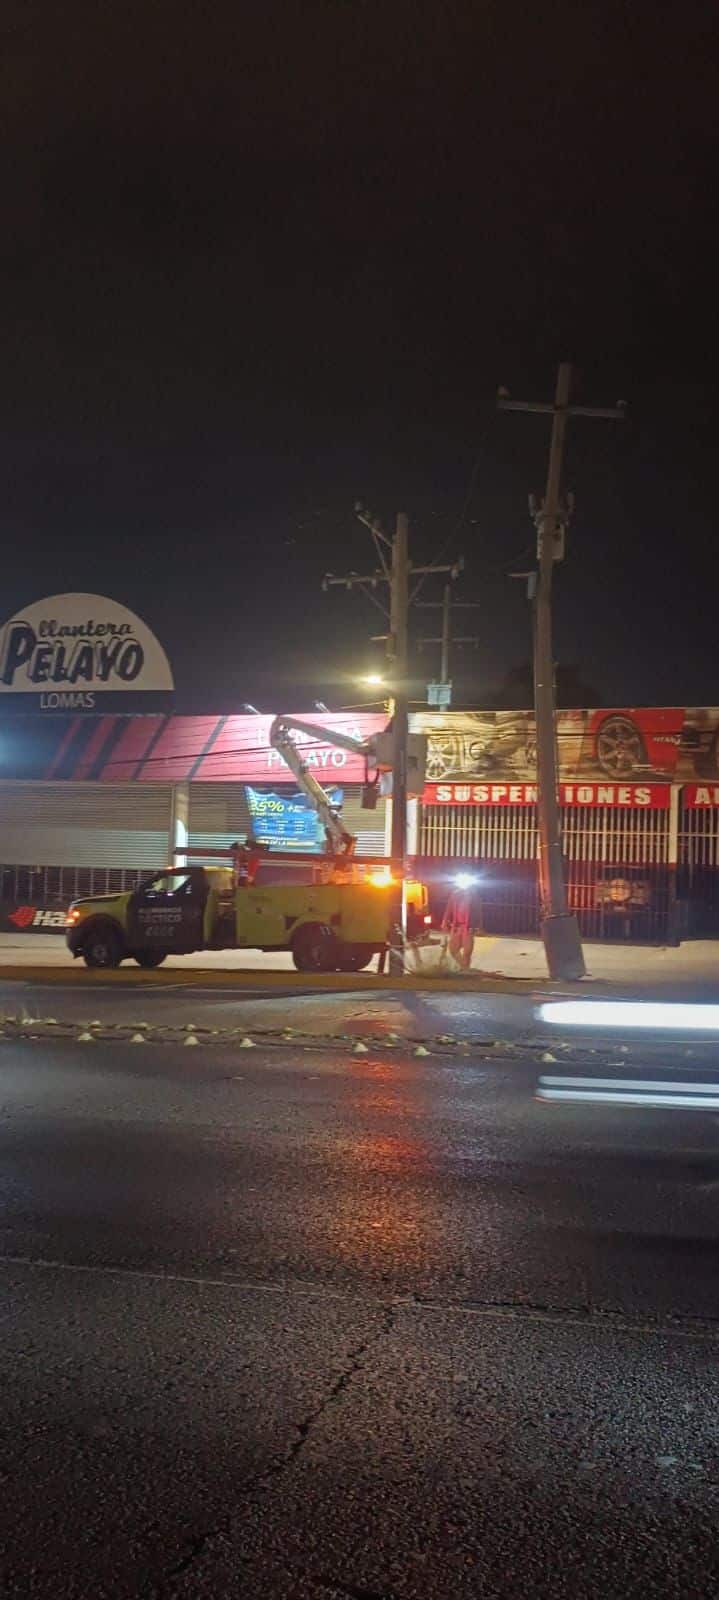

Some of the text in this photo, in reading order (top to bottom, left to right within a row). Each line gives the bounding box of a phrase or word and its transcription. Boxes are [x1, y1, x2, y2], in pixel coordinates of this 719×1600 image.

[38, 620, 134, 637] llantera
[0, 620, 144, 685] PELAYO
[40, 692, 95, 709] LOMAS
[267, 750, 347, 767] PAYO
[436, 784, 651, 805] SUSPENIONES
